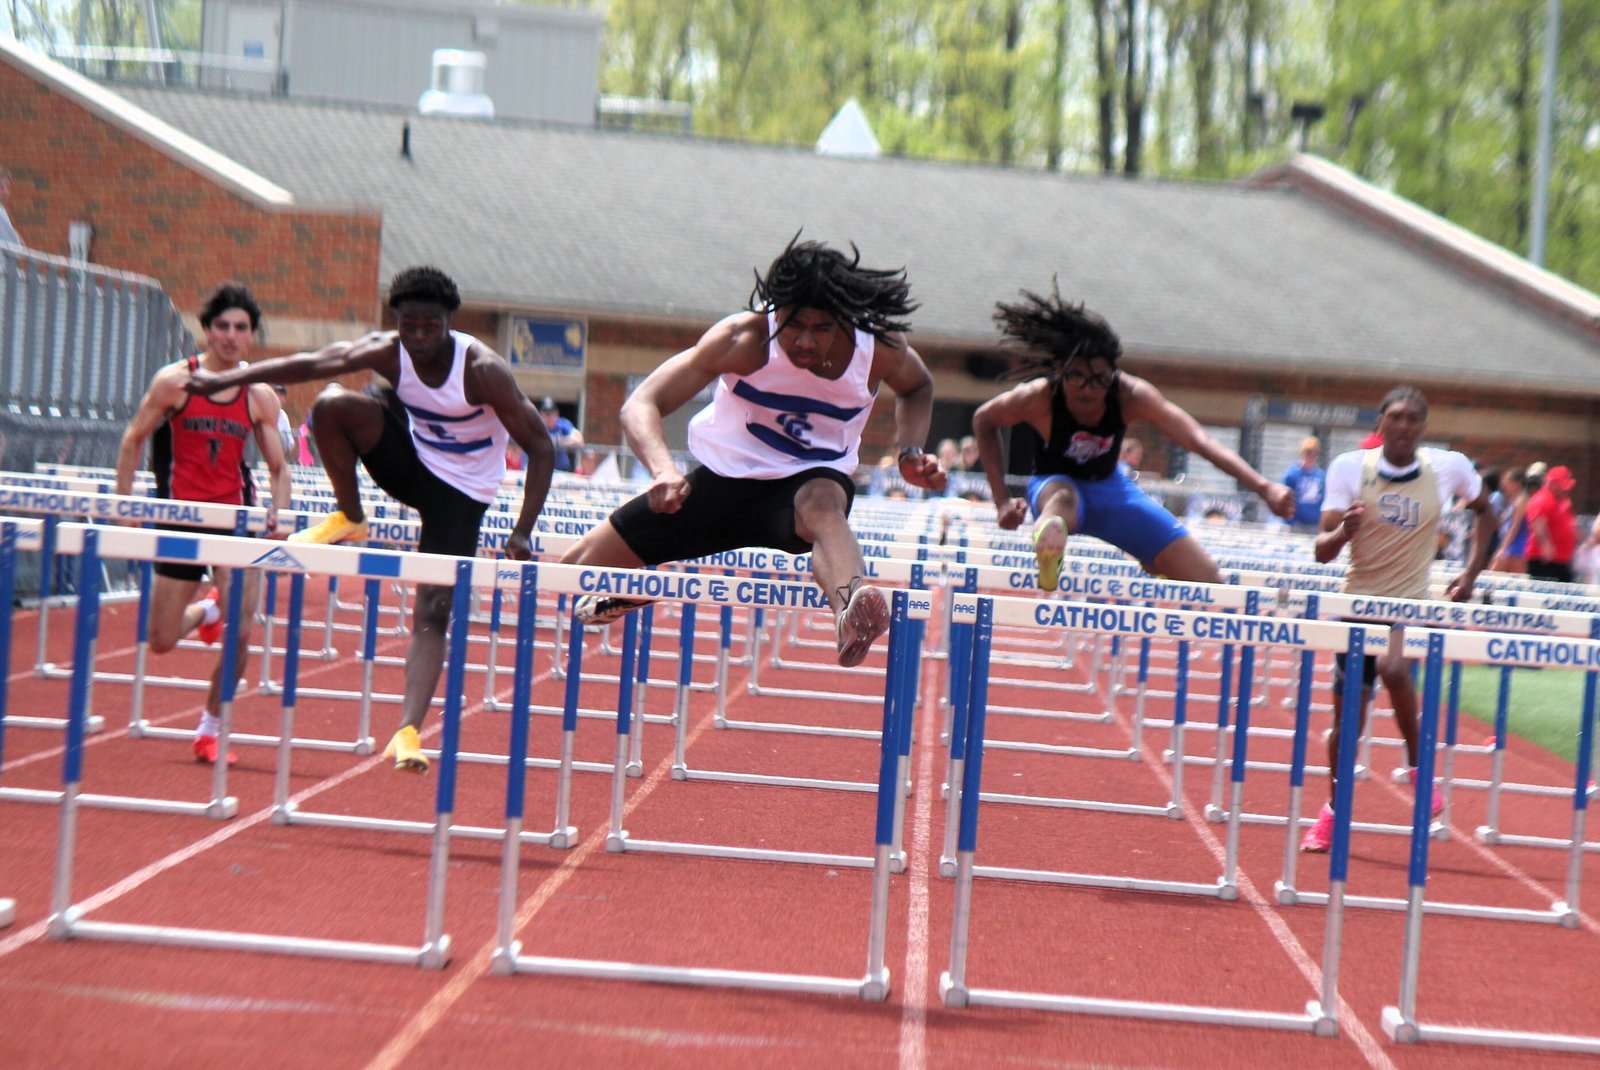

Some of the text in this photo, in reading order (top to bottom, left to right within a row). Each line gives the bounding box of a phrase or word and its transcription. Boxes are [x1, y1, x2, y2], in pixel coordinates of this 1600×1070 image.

[117, 500, 203, 523] CENTRAL
[541, 507, 593, 520] ATHOLIC
[368, 522, 419, 542] THOLI
[555, 521, 599, 536] CENT
[1088, 562, 1151, 579] CENTRA
[579, 570, 702, 600] CATHOLIC
[736, 582, 830, 609] CENTRA
[1009, 572, 1102, 595] CAOLIC
[1129, 582, 1215, 603] CENTRAL
[1035, 604, 1158, 634] CATHOLIC
[1193, 616, 1306, 645] CENTRAL
[1351, 599, 1447, 621] CATHOLIC
[1472, 609, 1559, 630] CENTRAL
